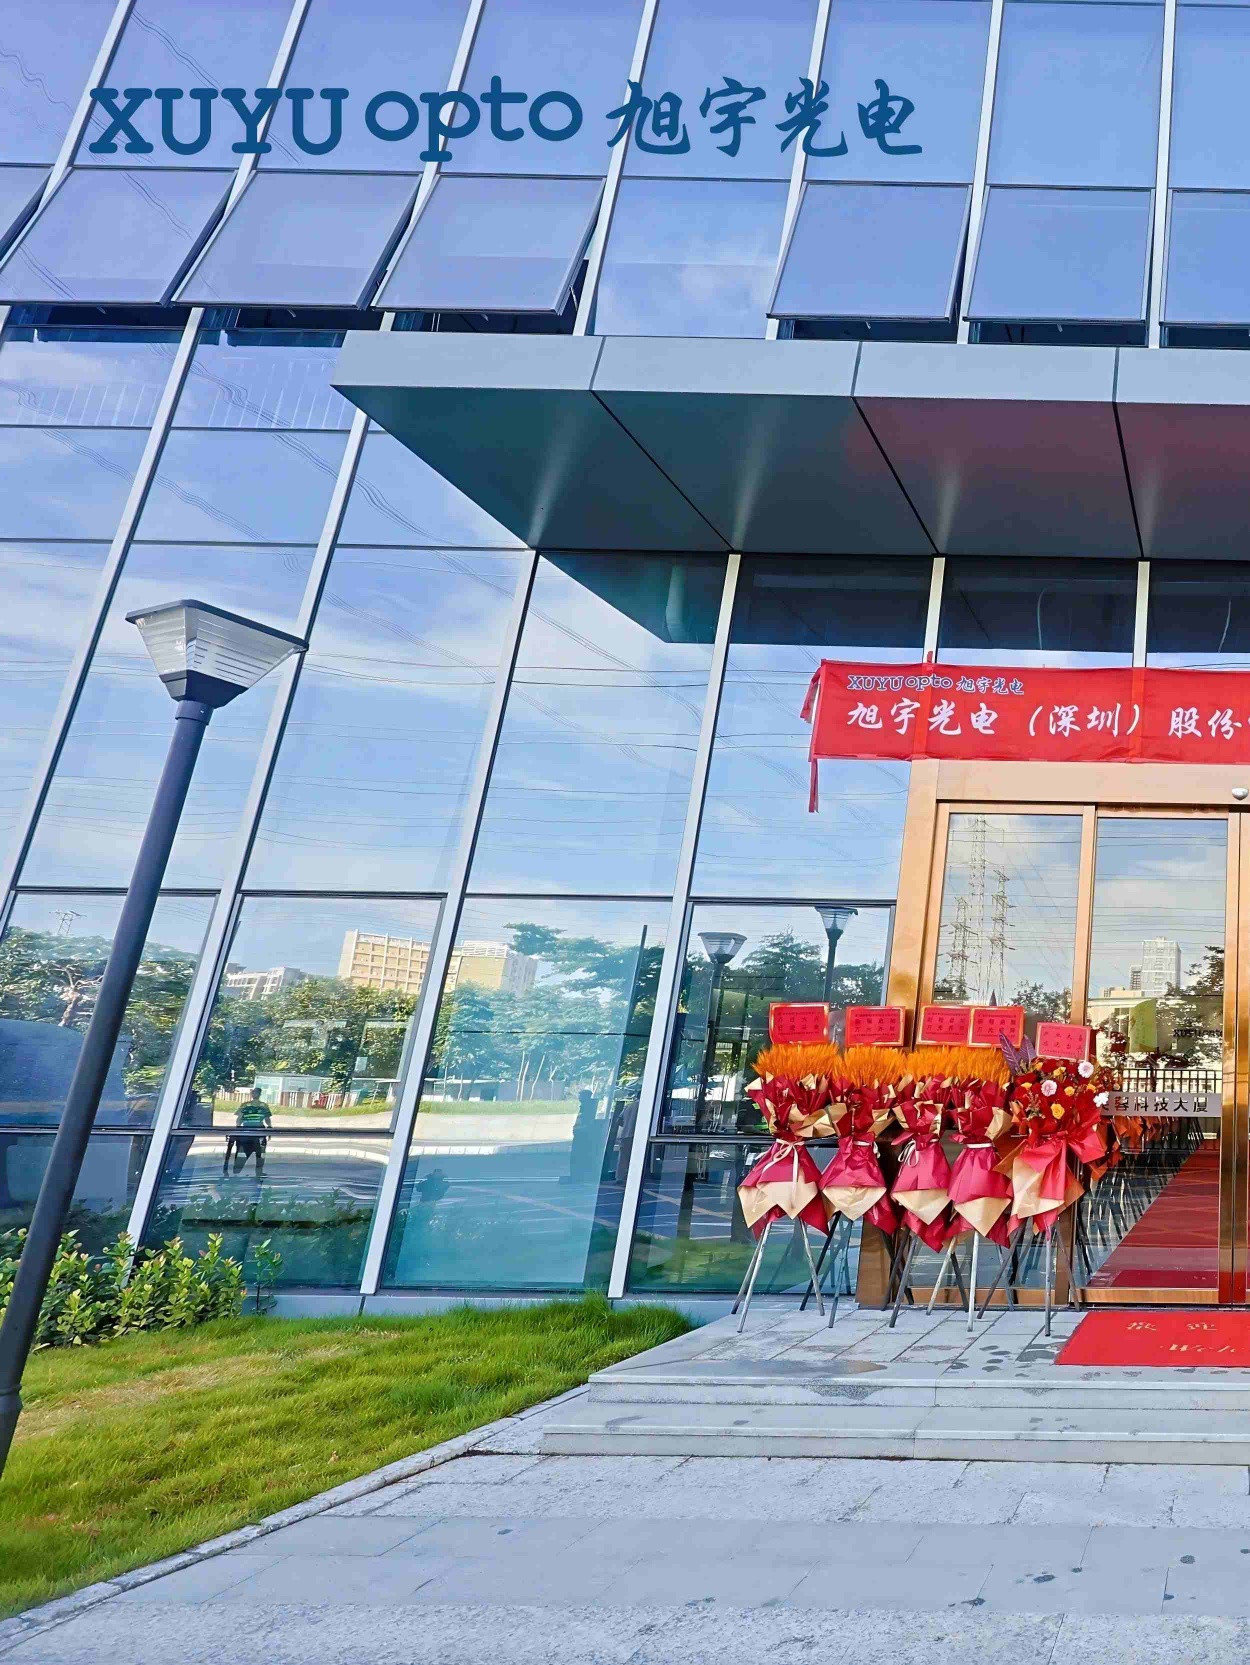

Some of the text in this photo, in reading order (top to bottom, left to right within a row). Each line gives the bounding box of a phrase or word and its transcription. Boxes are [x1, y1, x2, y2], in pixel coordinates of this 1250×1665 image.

[847, 674, 1025, 695] XUYU opto 旭宇光电
